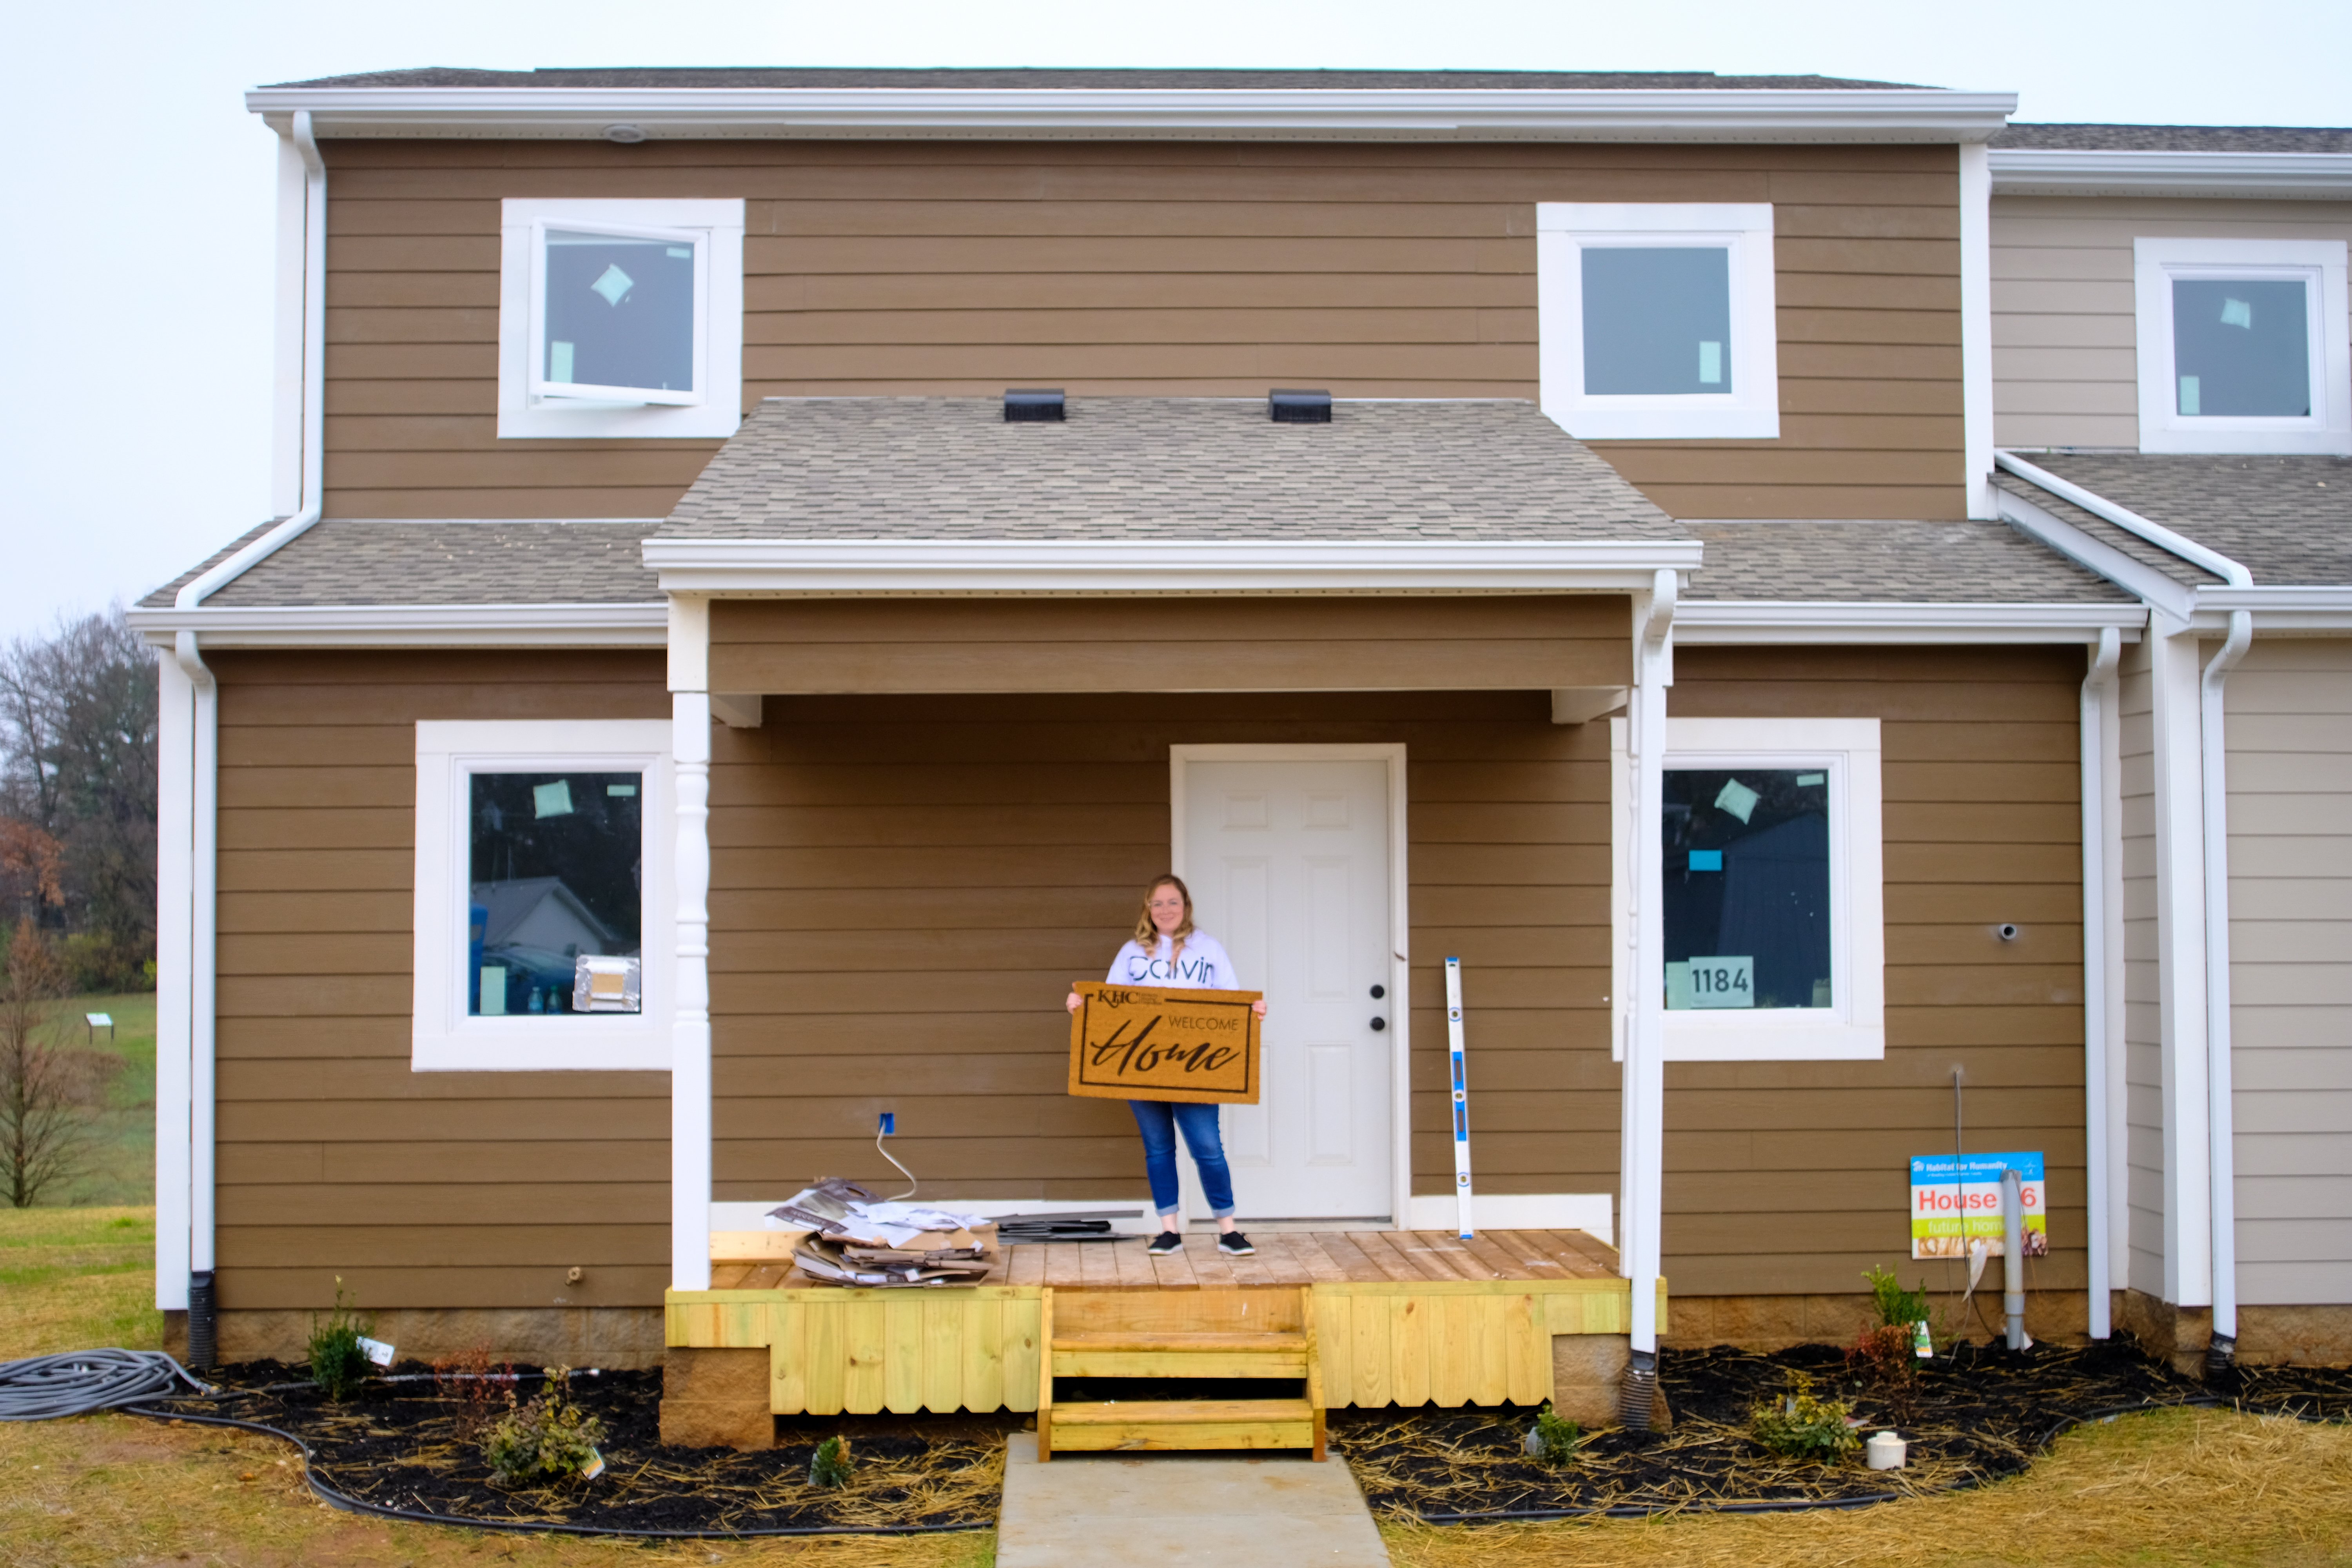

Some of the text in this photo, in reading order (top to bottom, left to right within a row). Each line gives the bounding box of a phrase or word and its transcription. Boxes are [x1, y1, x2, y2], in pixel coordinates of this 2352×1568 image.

[1692, 968, 1748, 993] 1184
[1098, 990, 1138, 1008] KHC
[1168, 1015, 1239, 1031] WELCOME
[1089, 1015, 1241, 1076] Home
[1919, 1190, 1997, 1210] House
[1928, 1219, 2003, 1234] future hom
